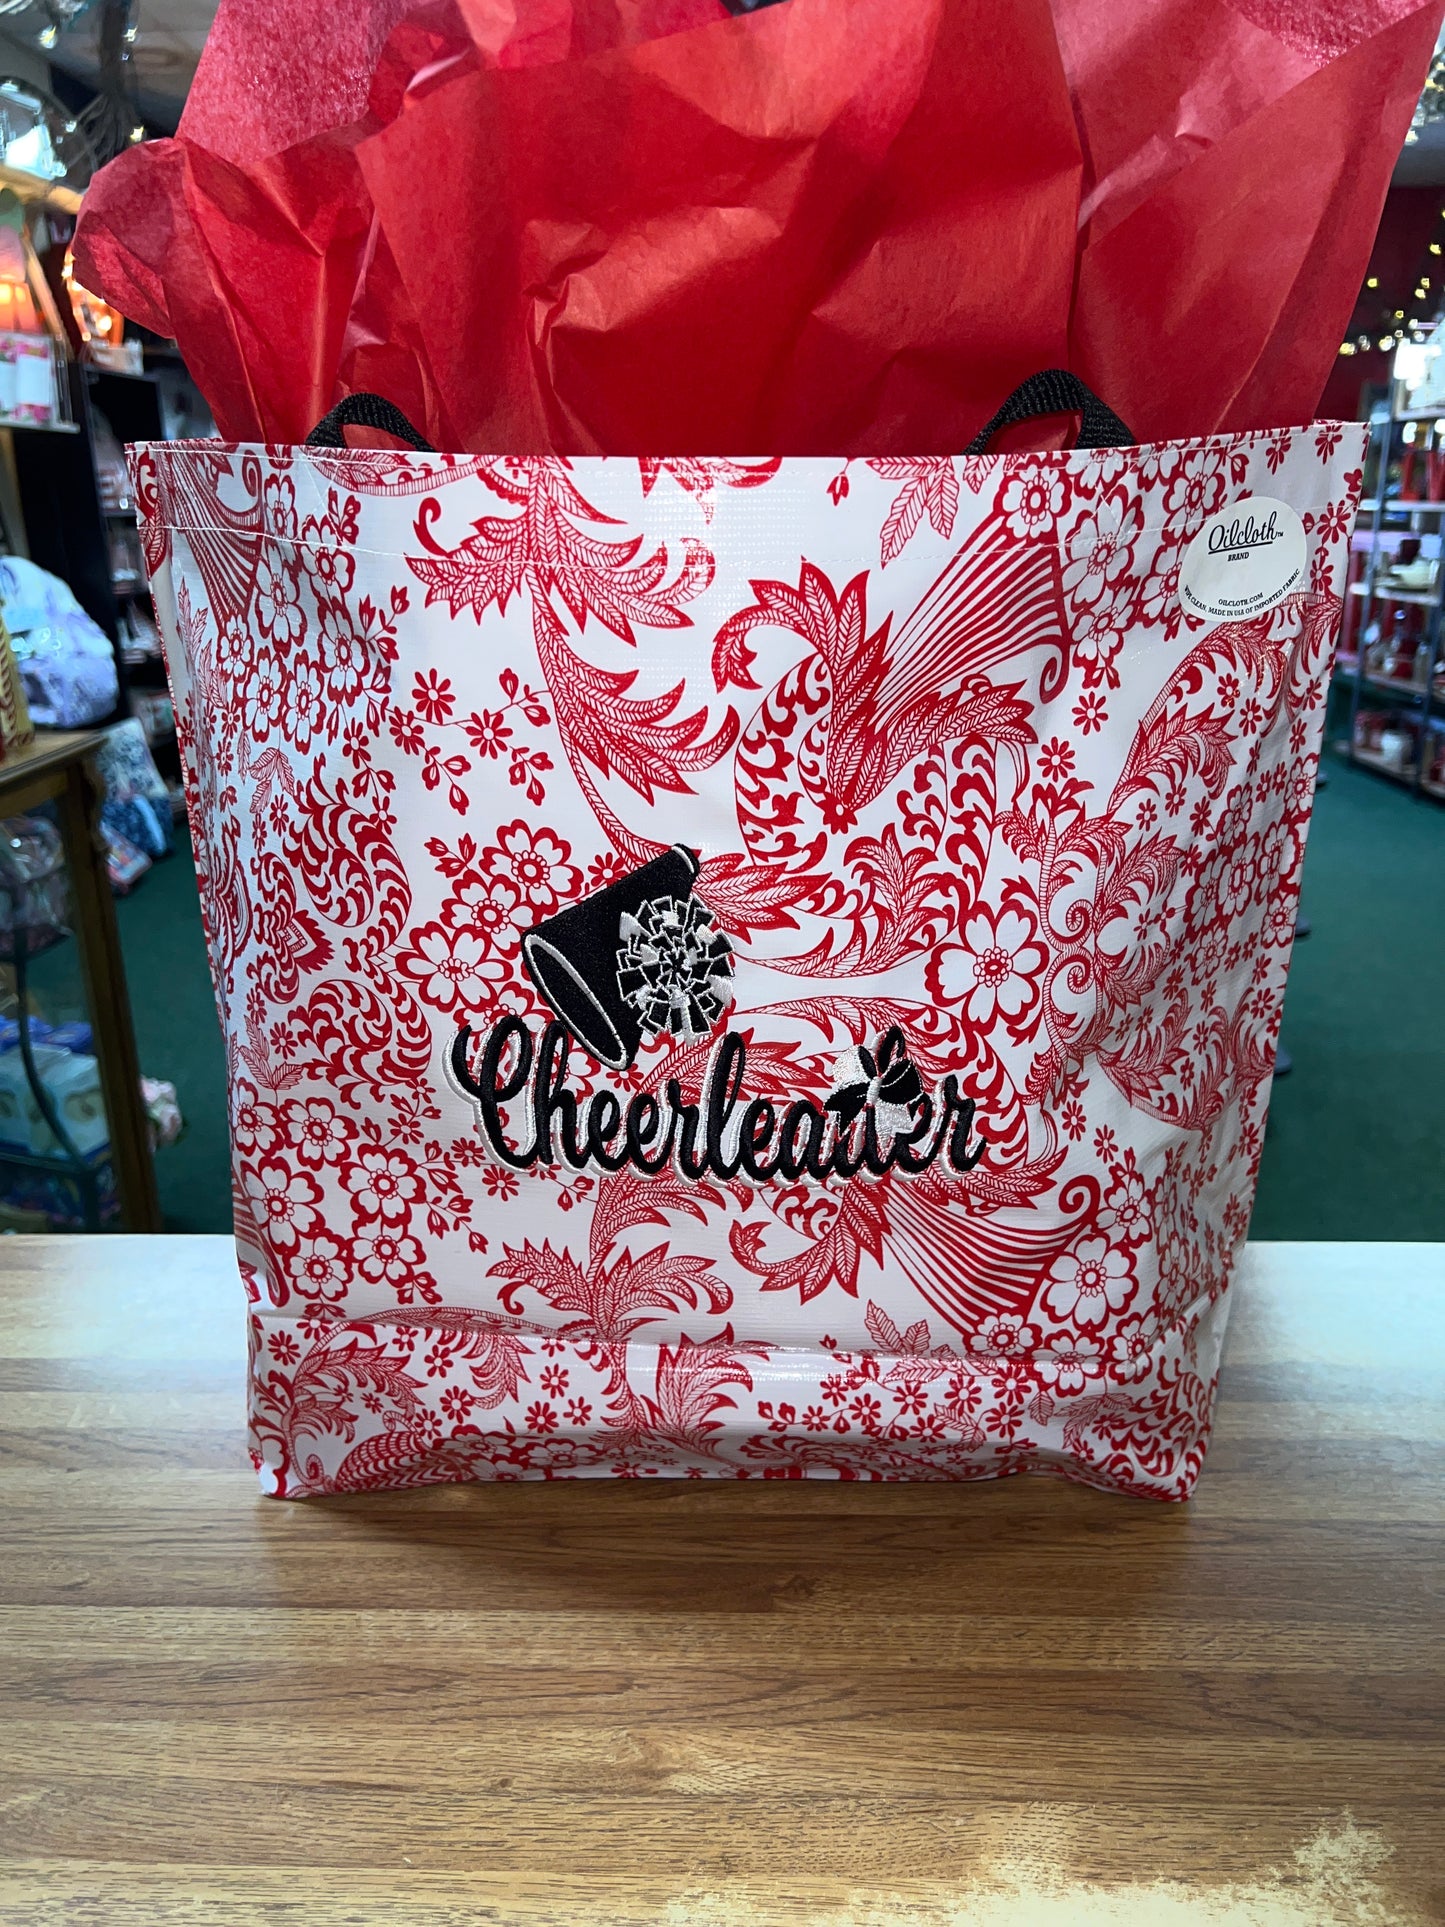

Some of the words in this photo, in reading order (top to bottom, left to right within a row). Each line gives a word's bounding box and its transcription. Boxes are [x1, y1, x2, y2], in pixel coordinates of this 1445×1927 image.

[1227, 552, 1250, 562] BRAND
[1208, 607, 1225, 616] MADE
[1254, 589, 1283, 611] IMPORTED
[1282, 568, 1300, 592] FABRIC
[1218, 592, 1264, 607] OILCLOTH.COM
[443, 1015, 988, 1187] Cheerleader
